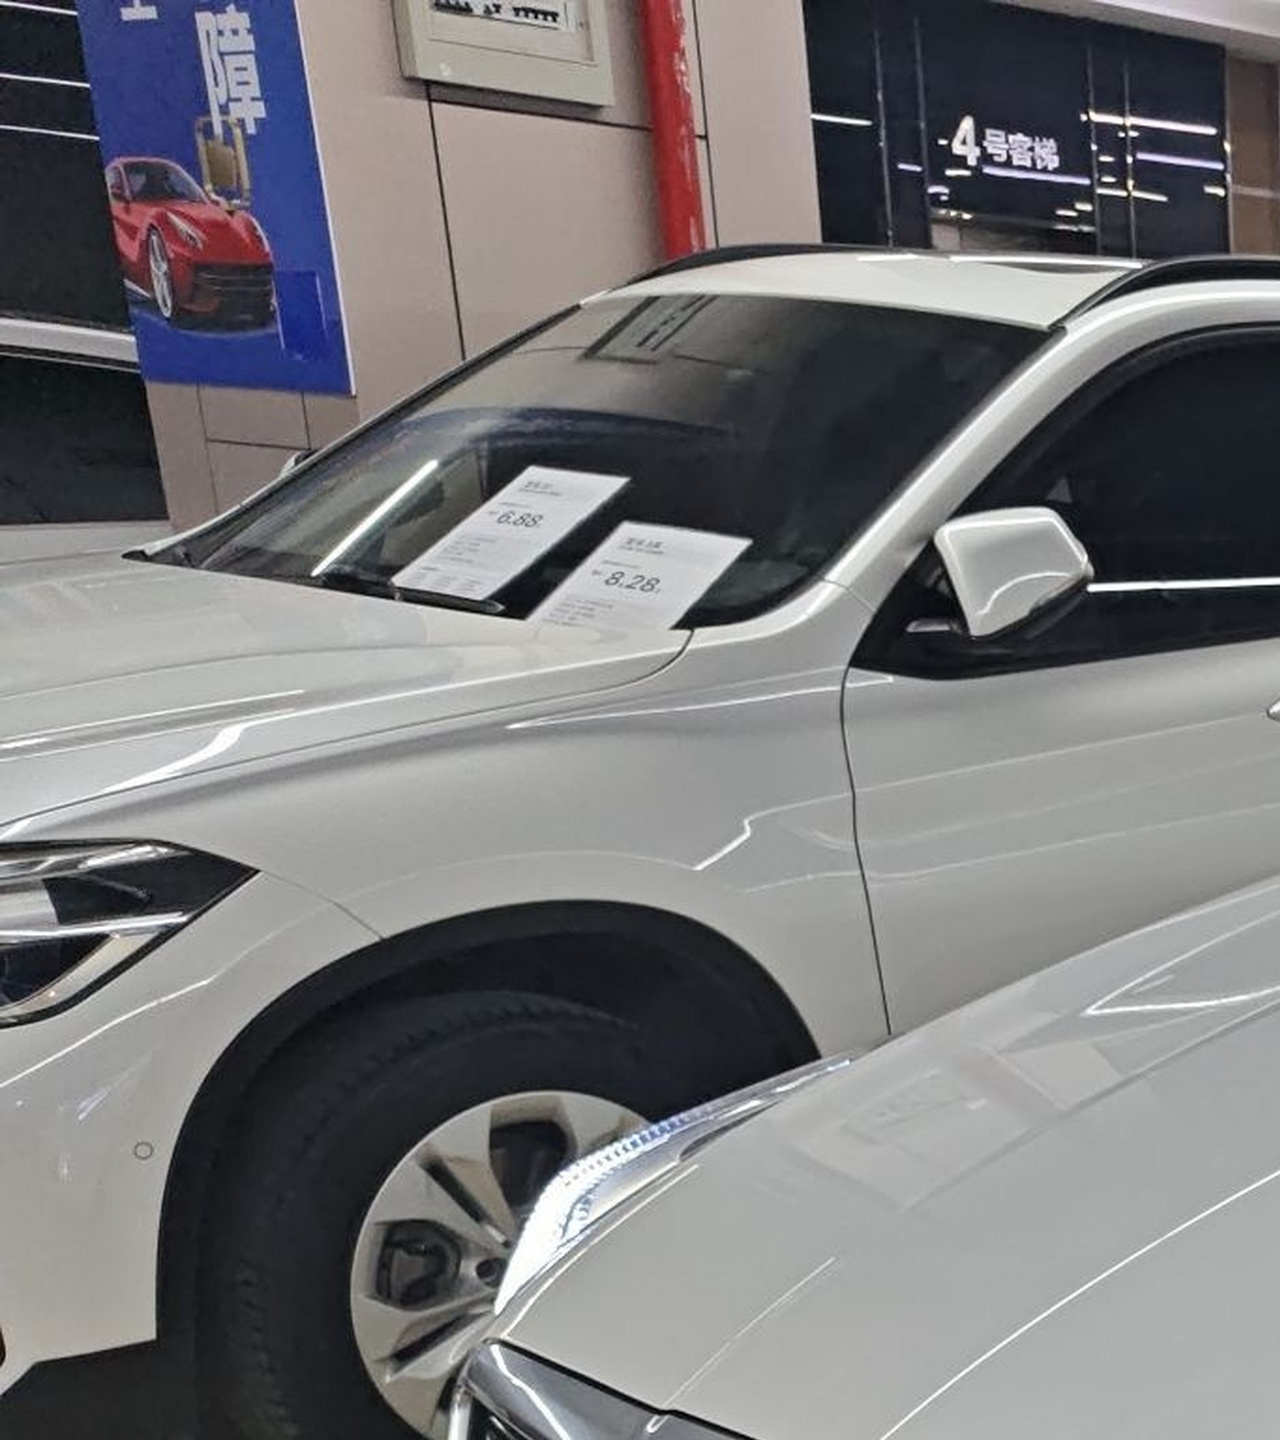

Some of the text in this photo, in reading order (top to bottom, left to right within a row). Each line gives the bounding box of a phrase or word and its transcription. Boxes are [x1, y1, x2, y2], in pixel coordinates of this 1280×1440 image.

[951, 115, 1060, 171] 4号客梯
[603, 570, 661, 594] 8.28
